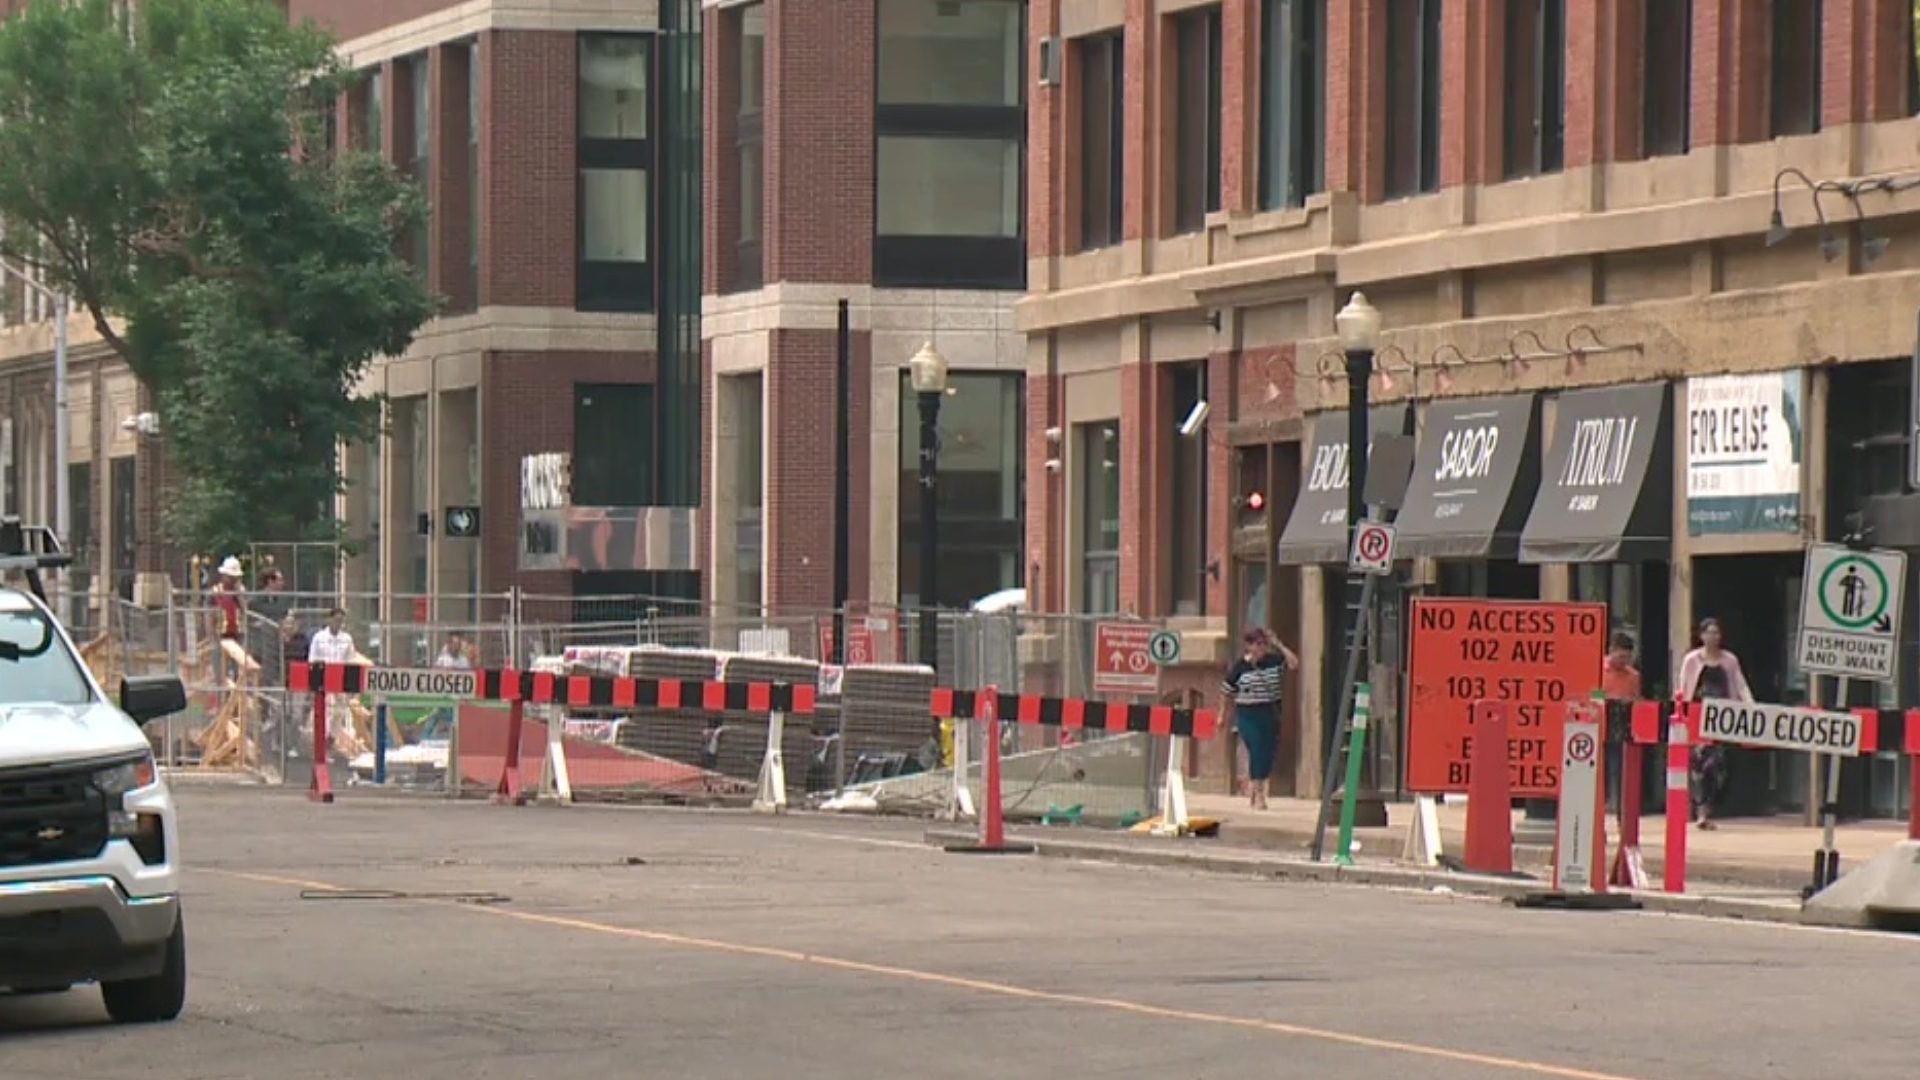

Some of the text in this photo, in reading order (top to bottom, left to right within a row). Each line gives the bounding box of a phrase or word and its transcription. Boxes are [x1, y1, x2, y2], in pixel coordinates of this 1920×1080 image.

[1690, 404, 1768, 455] FOR LEASE
[1435, 426, 1498, 481] SABOR
[1558, 417, 1637, 486] ATRIUM
[1420, 608, 1596, 635] NO ACCESS TO
[1460, 639, 1555, 663] 102 AVE
[1808, 635, 1887, 656] DISMOUNT
[1805, 651, 1885, 671] AND WALK
[367, 670, 474, 694] ROAD CLOSED
[1447, 676, 1564, 701] 103 ST TO
[1518, 705, 1545, 726] ST
[1703, 705, 1856, 748] ROAD CLOSED
[1462, 737, 1546, 760] EEPT
[1449, 762, 1557, 788] BILES
